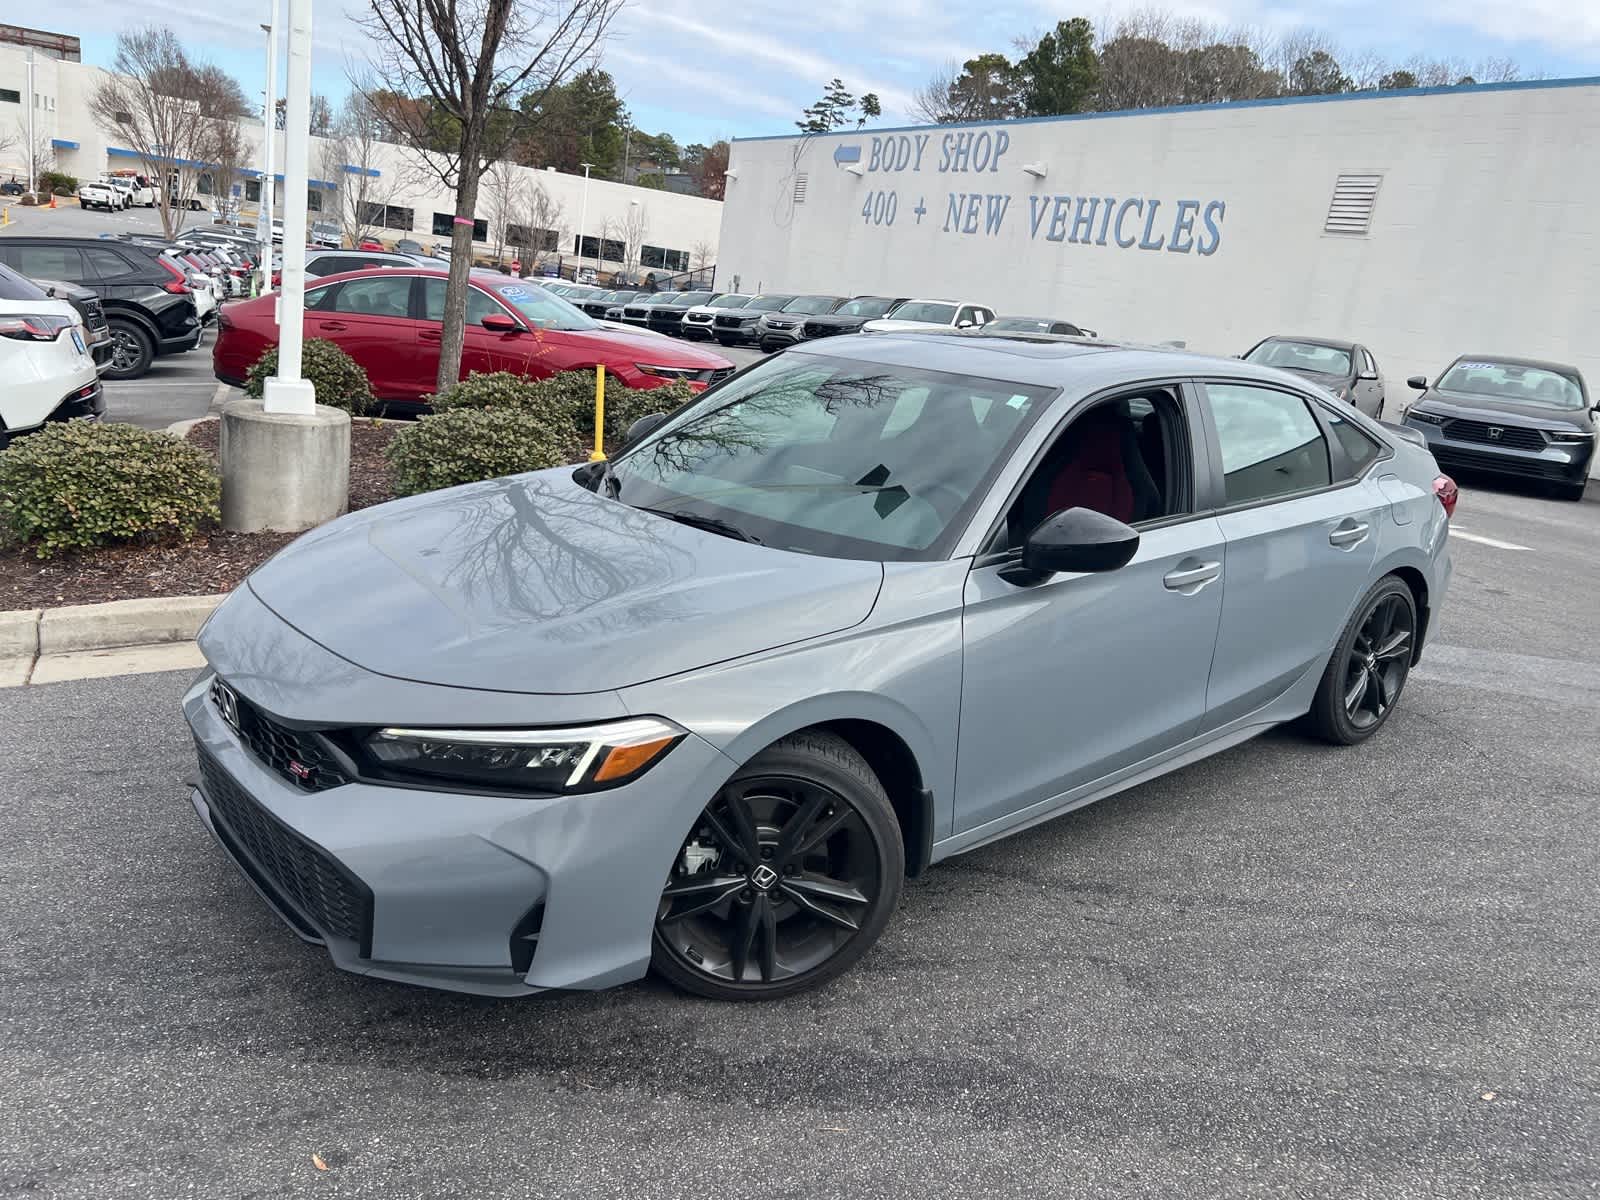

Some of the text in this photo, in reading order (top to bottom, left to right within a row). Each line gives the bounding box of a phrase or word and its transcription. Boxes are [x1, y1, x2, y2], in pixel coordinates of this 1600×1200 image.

[869, 131, 1009, 172] BODY SHOP
[862, 191, 1226, 256] 400 + NEW VEHICLES
